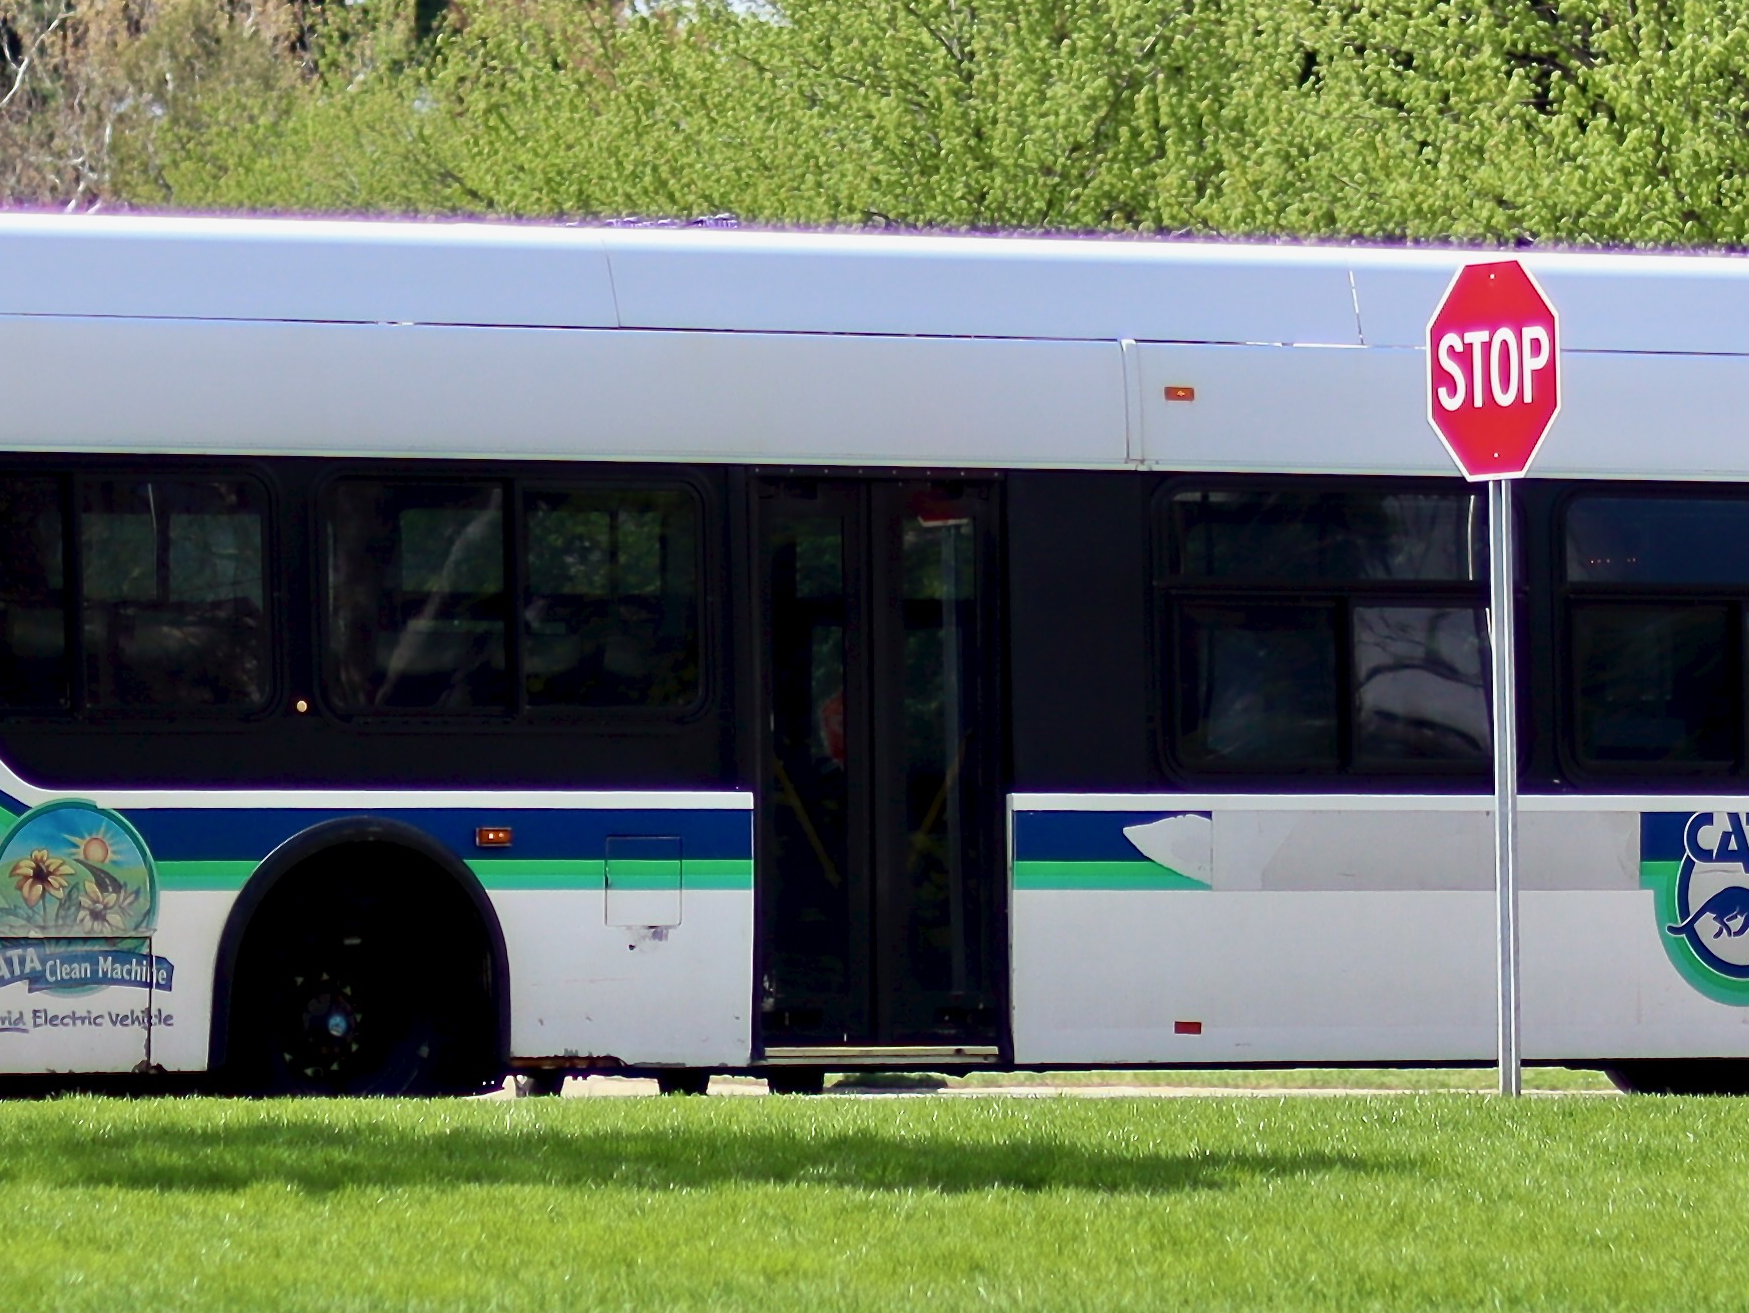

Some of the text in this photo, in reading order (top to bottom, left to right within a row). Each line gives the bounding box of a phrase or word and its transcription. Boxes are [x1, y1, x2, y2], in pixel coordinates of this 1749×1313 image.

[1437, 326, 1550, 411] STOP
[45, 958, 91, 983] Clean
[32, 1008, 105, 1029] Electric
